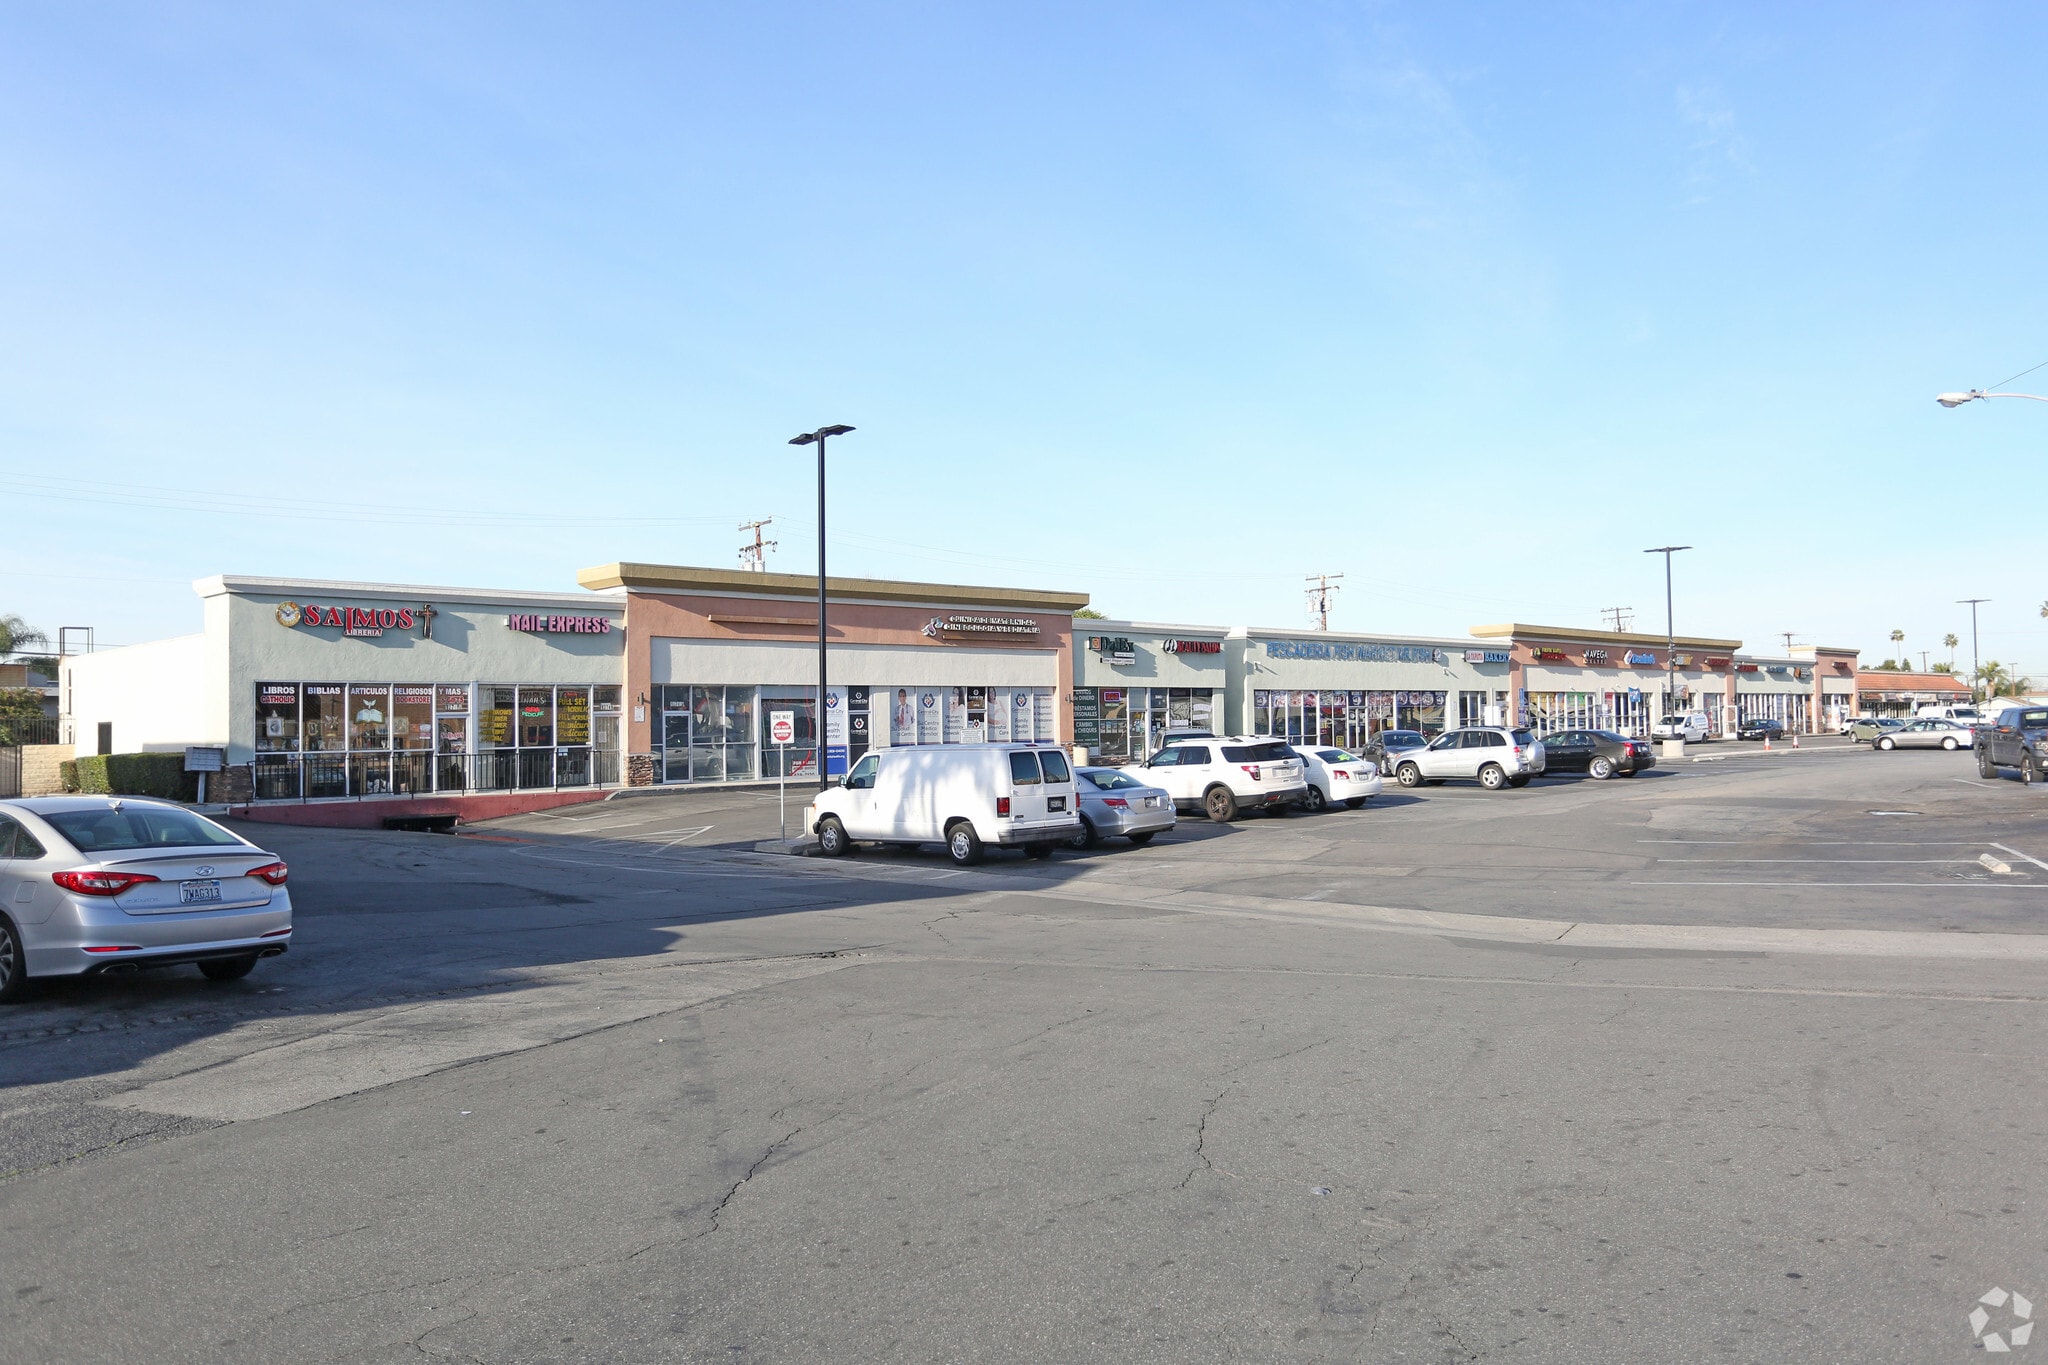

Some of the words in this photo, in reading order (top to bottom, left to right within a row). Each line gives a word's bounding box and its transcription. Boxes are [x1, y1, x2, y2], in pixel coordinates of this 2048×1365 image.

[509, 614, 544, 631] NAIL
[548, 615, 610, 633] EXPRESS
[1266, 641, 1331, 658] PESCADERIA
[1485, 652, 1511, 662] BAKERY
[1585, 650, 1608, 659] NAVEGA
[351, 687, 387, 695] ARTICULOS
[261, 695, 296, 704] CATHOLIC
[395, 696, 431, 704] BOOKSTORE
[184, 888, 221, 899] 7WAG313
